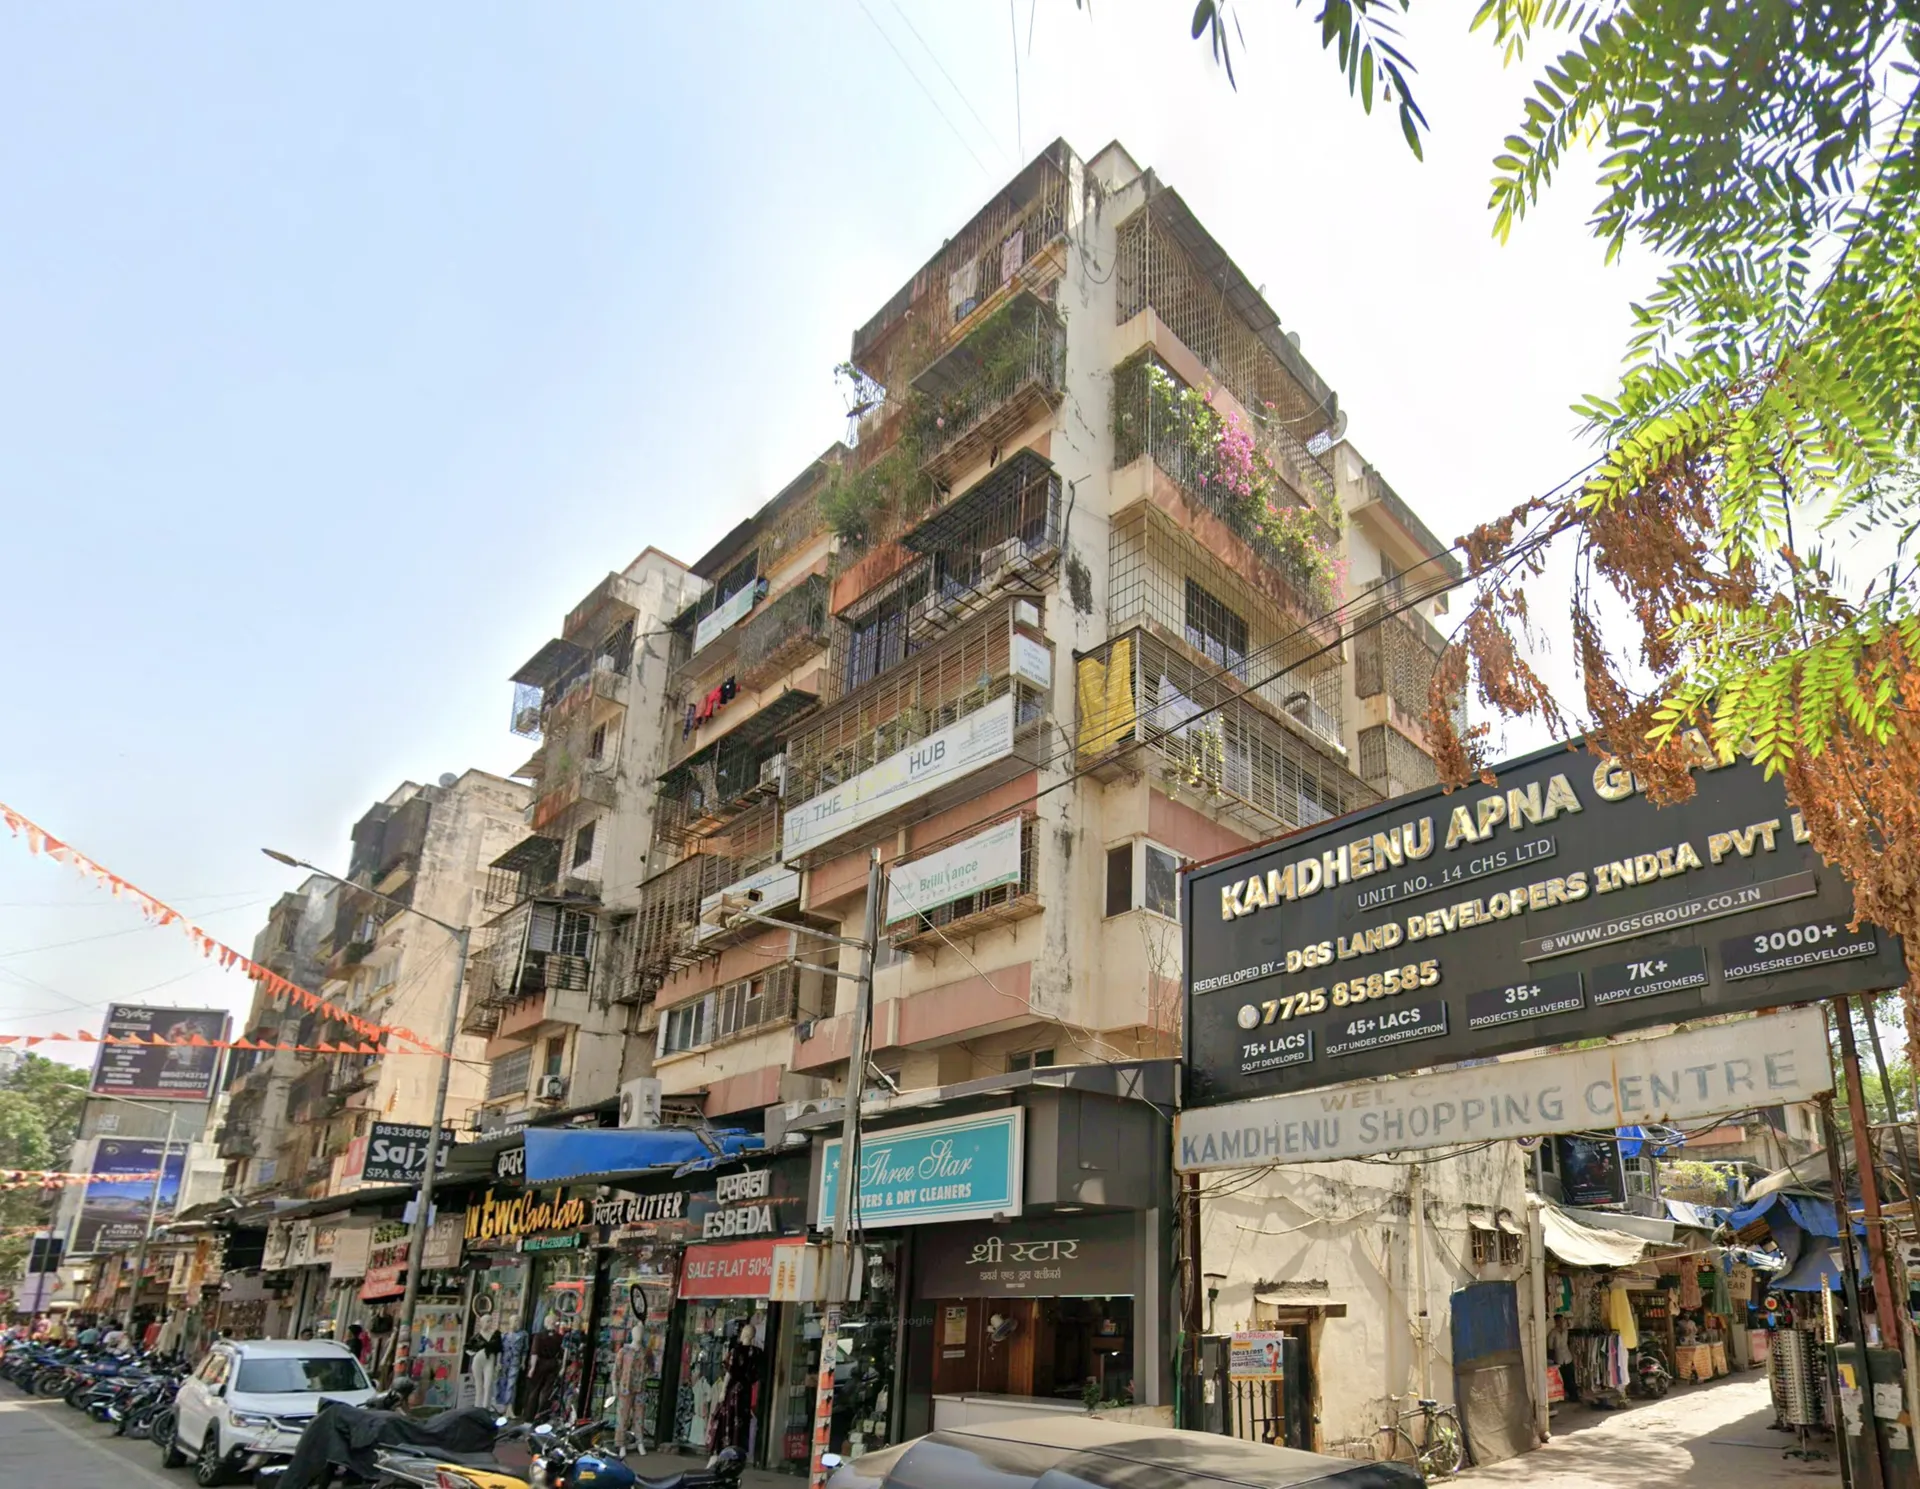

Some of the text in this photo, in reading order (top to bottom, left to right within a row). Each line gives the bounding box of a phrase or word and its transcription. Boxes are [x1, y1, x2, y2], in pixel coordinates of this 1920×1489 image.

[812, 795, 843, 823] THE
[908, 740, 947, 775] HUB
[1220, 728, 1758, 922] KAMDHENU APNA GA
[1358, 838, 1551, 908] UNIT NO. 14 CHS LTD
[1193, 965, 1260, 994] REDEVELOPED
[1260, 961, 1275, 976] BY
[1286, 941, 1335, 973] DGS
[1337, 922, 1404, 960] LAND
[1407, 871, 1590, 942] DEVELOPERS
[1593, 840, 1703, 893] INDIA
[1707, 818, 1781, 864] PVT
[1555, 887, 1762, 948] WWW.DGSGROUP.CO.IN
[1753, 923, 1838, 954] 3000+
[1626, 959, 1668, 981] 7K+
[1723, 940, 1877, 980] HOUSESREDEVELOPED
[1261, 958, 1441, 1025] 7725 858585
[1504, 984, 1542, 1004] 35+
[1594, 973, 1706, 1004] HAPPY CUSTOMERS
[1346, 1008, 1422, 1037] 45+ LACS
[1469, 998, 1580, 1028] PROJECTS DELIVERED
[1242, 1033, 1306, 1059] 75+ LACS
[1326, 1022, 1444, 1055] SQ.FT UNDER CONSTRUCTION
[1241, 1051, 1305, 1072] SQ.FT DEVELOPED
[1181, 1050, 1799, 1166] KAMDHENU SHOPPING CENTRE
[375, 1124, 453, 1142] 98336509
[365, 1167, 391, 1179] SPA
[392, 1169, 404, 1180] &
[860, 1138, 974, 1188] Three Star
[626, 1191, 683, 1223] GLITTER
[853, 1181, 973, 1209] YERS & DRY CLEANERS
[702, 1204, 775, 1239] ESBEDA
[1009, 1238, 1081, 1263] स्टार
[687, 1260, 715, 1280] SALE
[716, 1257, 746, 1279] FLAT
[746, 1256, 772, 1276] 50%
[1727, 1269, 1748, 1279] N'S
[1727, 1280, 1746, 1290] EAR
[1235, 1330, 1279, 1340] NO PARKING
